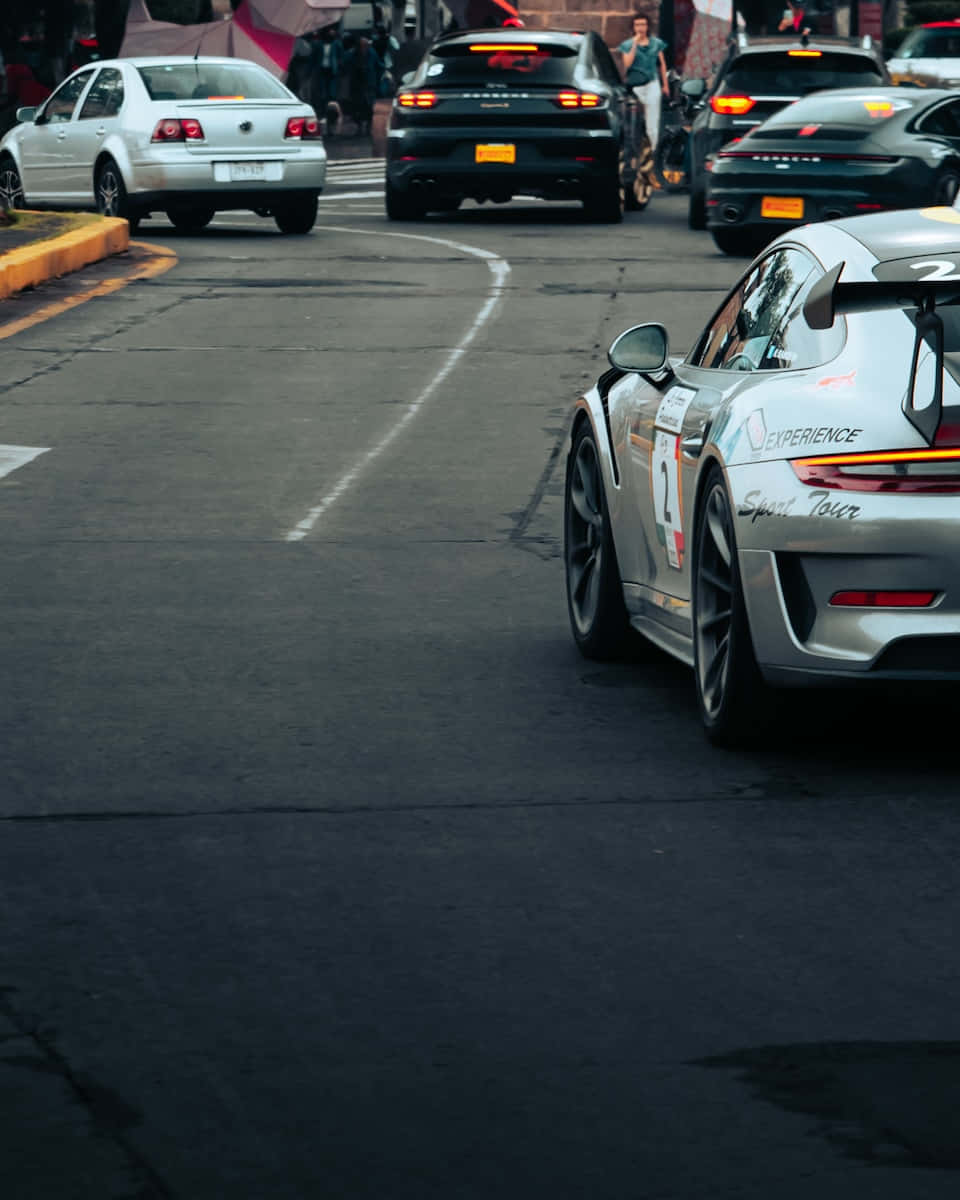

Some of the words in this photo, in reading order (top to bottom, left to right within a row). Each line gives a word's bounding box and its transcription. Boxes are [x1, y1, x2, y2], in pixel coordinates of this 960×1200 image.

[764, 427, 864, 451] EXPERIENCE
[660, 460, 672, 524] 2
[738, 489, 797, 524] Sport
[808, 490, 861, 521] Tour
